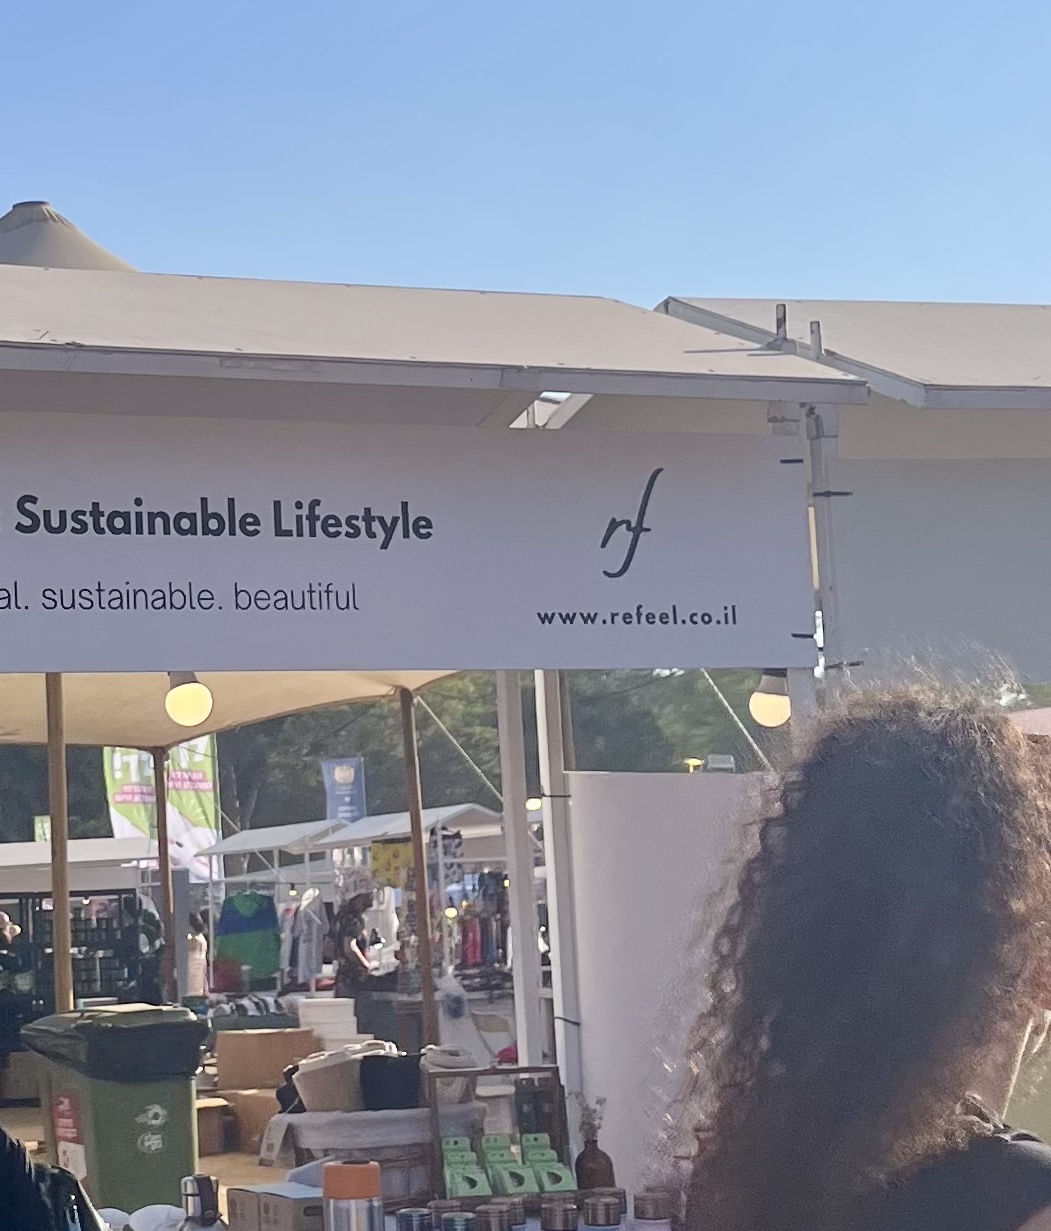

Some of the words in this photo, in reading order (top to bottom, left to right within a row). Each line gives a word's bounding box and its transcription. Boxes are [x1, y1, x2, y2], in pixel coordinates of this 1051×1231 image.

[14, 494, 262, 537] Sustainable
[273, 498, 434, 550] Lifestyle
[41, 581, 224, 611] sustainable.
[234, 581, 360, 611] beautiful
[536, 604, 738, 625] www.refeel.co.il
